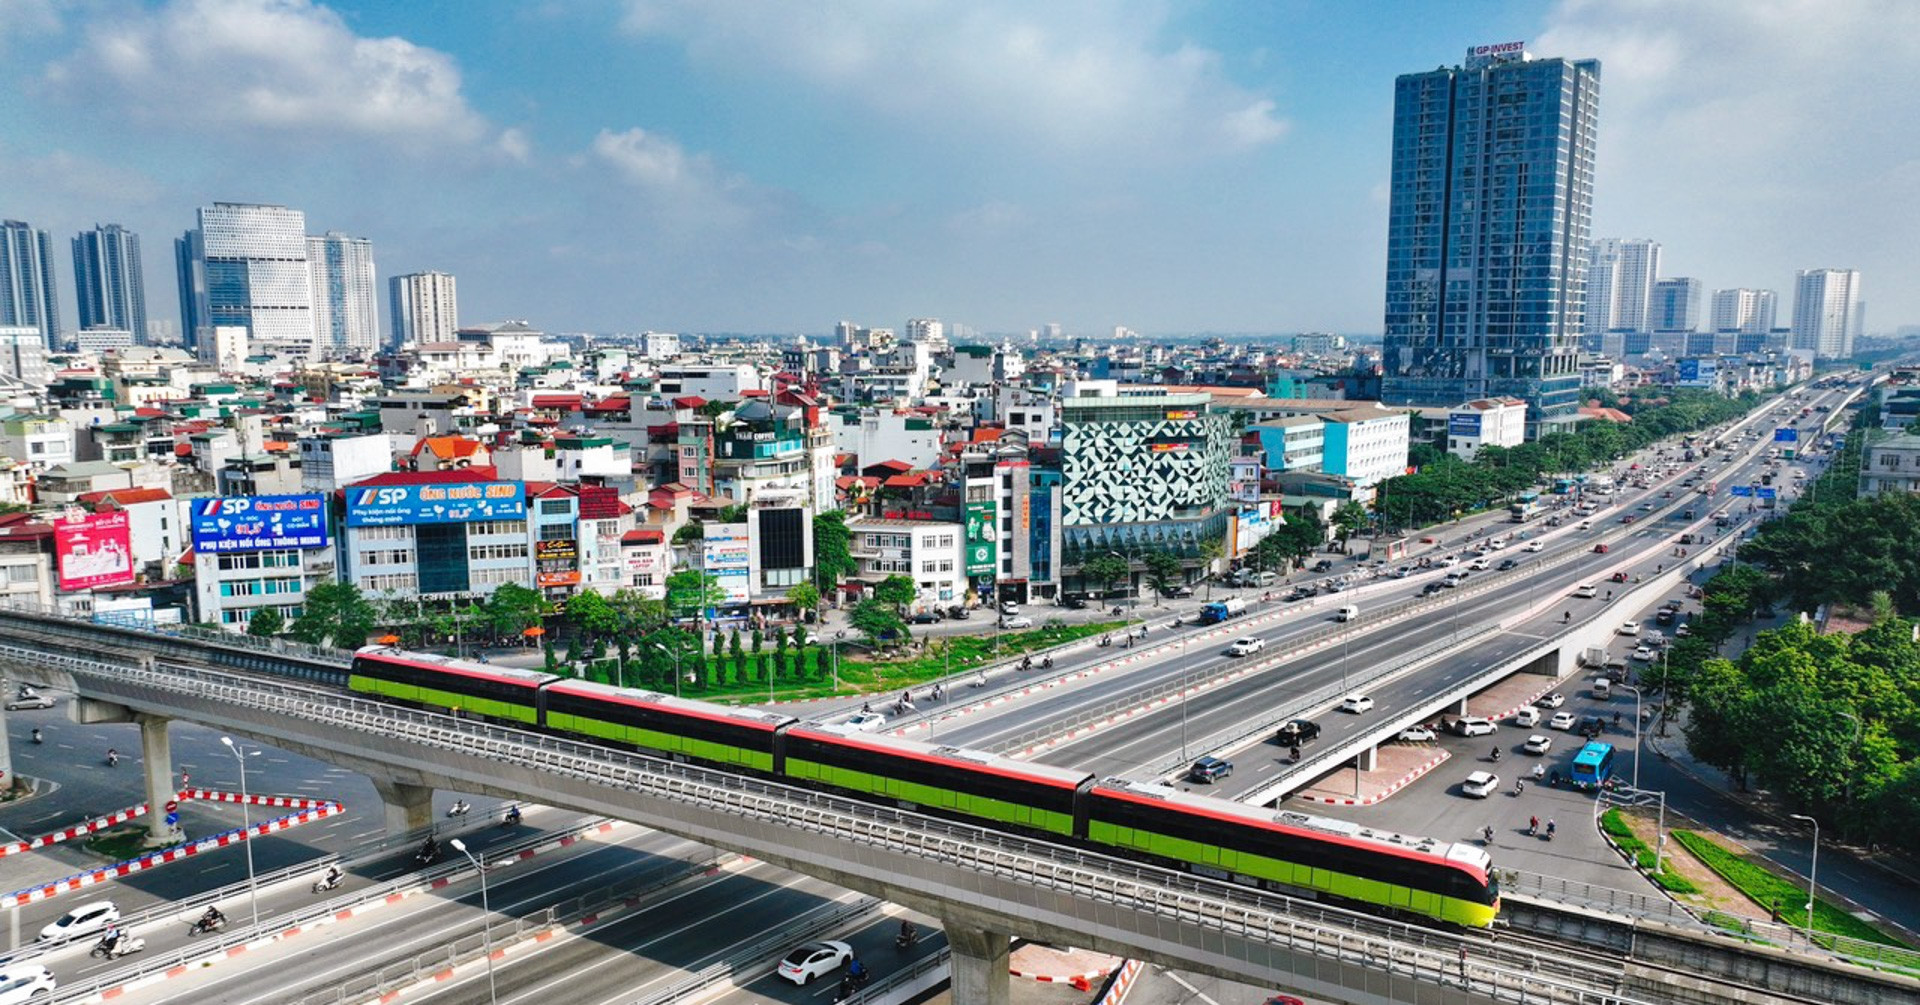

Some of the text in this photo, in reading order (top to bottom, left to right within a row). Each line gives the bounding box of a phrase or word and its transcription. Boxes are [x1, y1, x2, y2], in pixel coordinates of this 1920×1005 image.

[754, 431, 775, 440] COFFEE
[379, 488, 407, 505] SP
[419, 485, 446, 501] ỐNG
[447, 484, 482, 499] NƯỚC
[222, 499, 250, 515] SP
[200, 540, 217, 550] PHỤ
[218, 539, 237, 550] KIỆN
